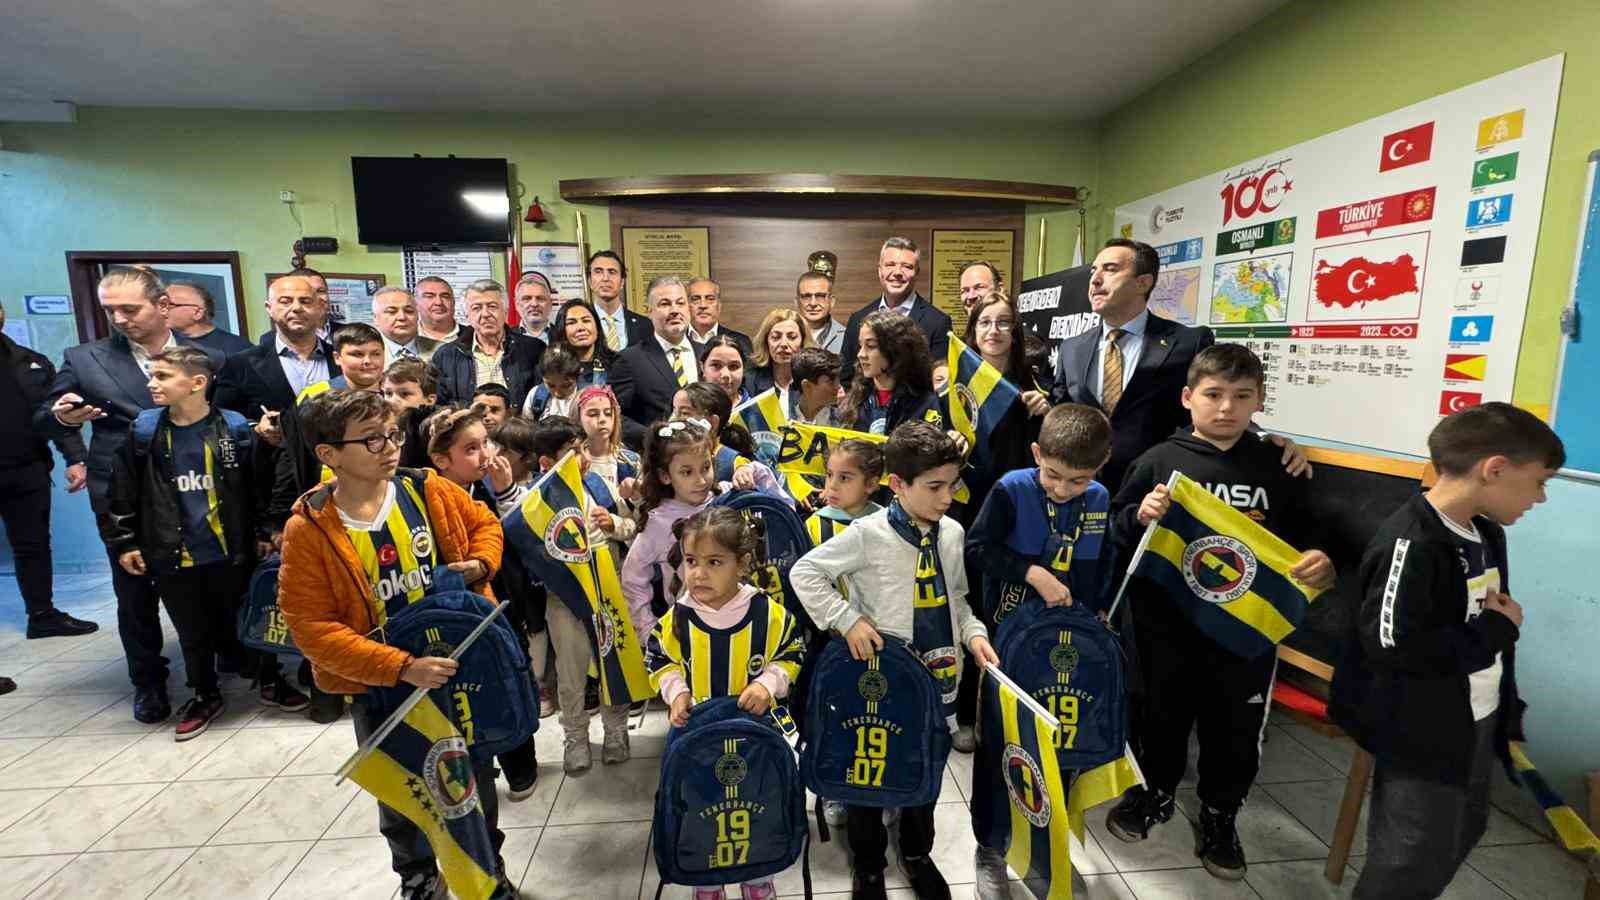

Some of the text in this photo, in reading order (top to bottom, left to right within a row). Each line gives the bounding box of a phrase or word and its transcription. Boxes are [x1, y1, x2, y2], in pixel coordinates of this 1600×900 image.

[1339, 200, 1385, 225] TÜRKİYE
[1231, 225, 1265, 244] OSMANLI
[855, 726, 888, 758] 19
[853, 758, 887, 786] 07
[716, 810, 750, 842] 19
[716, 840, 750, 867] 07
